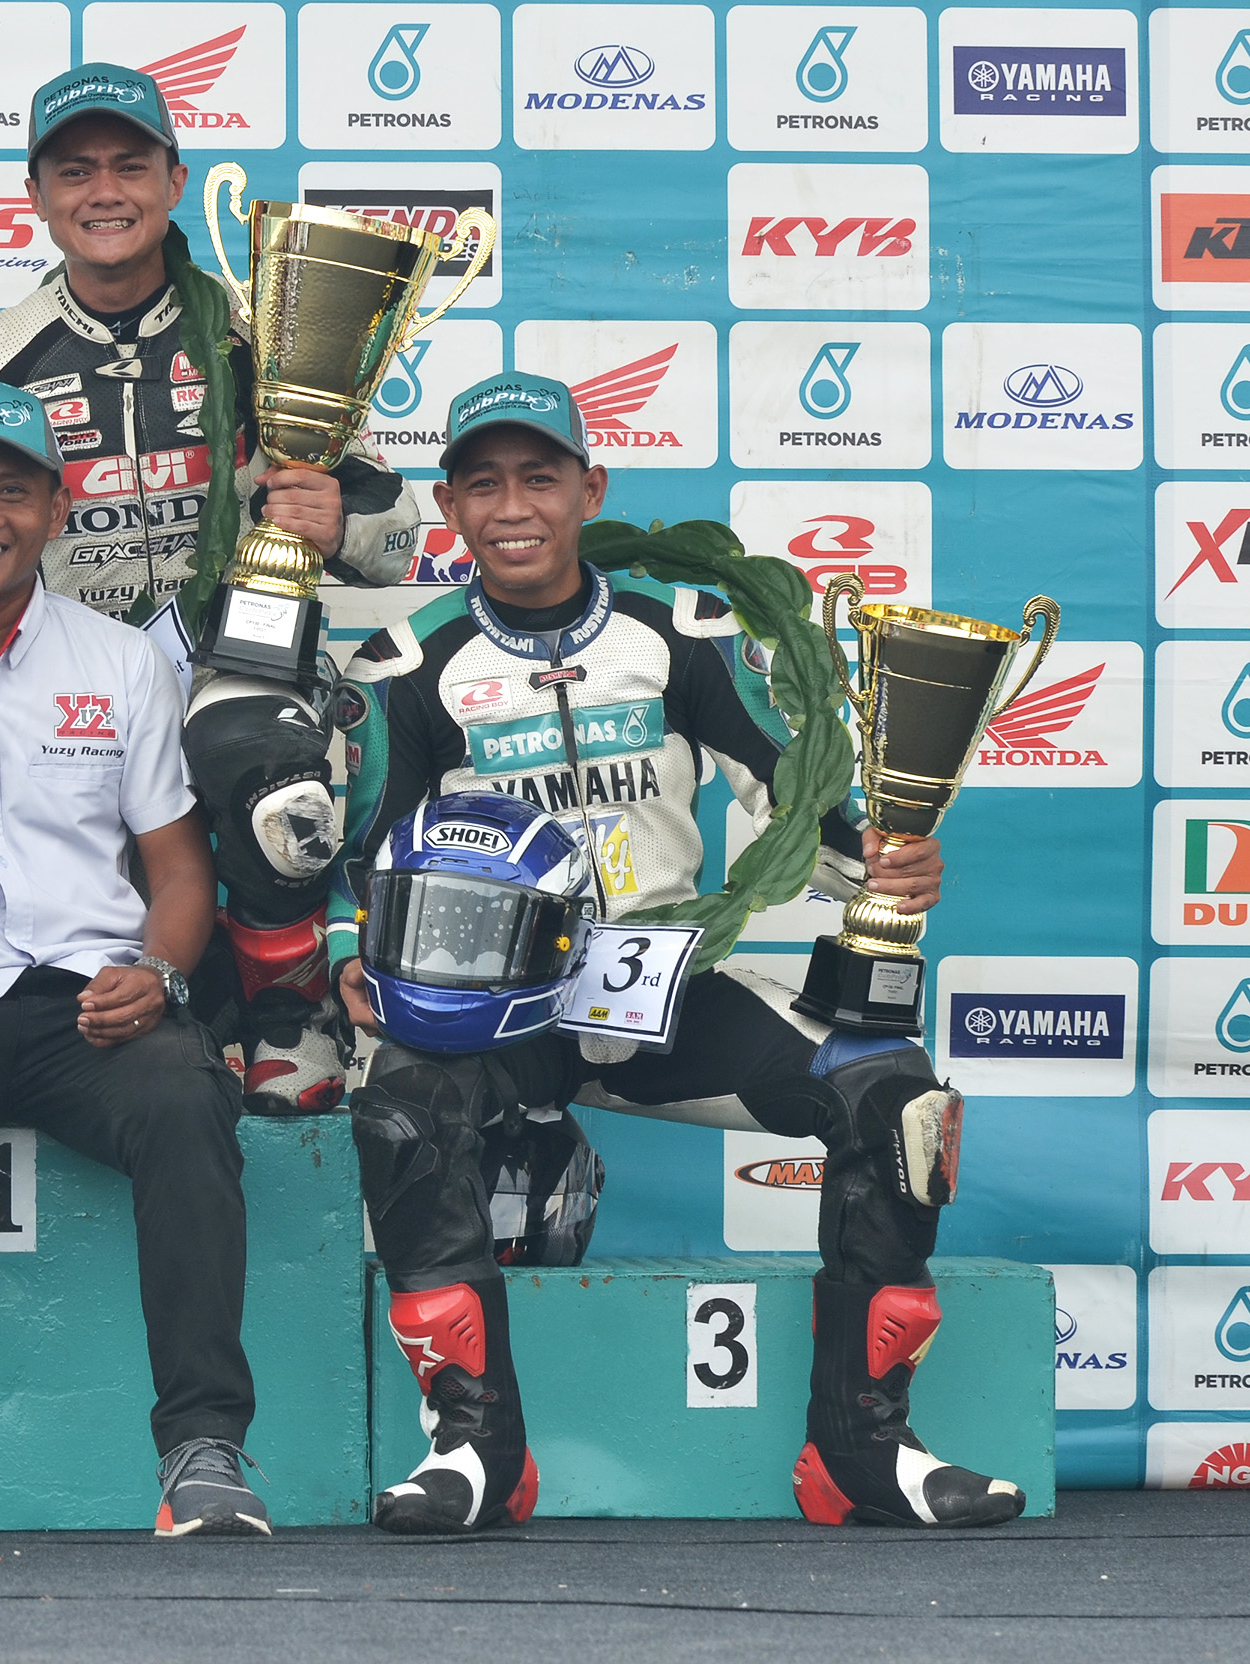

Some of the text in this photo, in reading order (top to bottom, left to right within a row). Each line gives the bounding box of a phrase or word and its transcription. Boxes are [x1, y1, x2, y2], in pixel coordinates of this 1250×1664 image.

[1001, 64, 1111, 91] YAMAHA
[43, 75, 110, 106] PETRONAS
[45, 84, 126, 114] CubPrix
[981, 93, 1103, 102] RACING
[524, 93, 705, 110] MODENAS
[173, 112, 251, 129] NDA
[348, 114, 451, 127] PETRONAS
[777, 115, 878, 129] PETRONAS
[1197, 117, 1250, 132] PETRO
[742, 217, 916, 256] KYB
[1183, 217, 1250, 259] KT
[54, 286, 94, 334] TAICHI
[176, 386, 206, 403] RK-
[457, 384, 523, 414] PETRONAS
[458, 392, 538, 423] CubPrix
[954, 413, 1133, 429] MODENAS
[373, 431, 447, 445] TRONA
[587, 431, 682, 448] ONDA
[780, 432, 881, 446] PETRONAS
[1201, 433, 1250, 448] PETRO
[82, 450, 188, 494] GIVI
[806, 565, 907, 594] CB
[78, 586, 135, 603] Yuzy
[570, 574, 608, 645] KUSHITANI
[470, 595, 534, 653] KUSHITANI
[459, 699, 509, 714] RACING BOY
[483, 720, 617, 760] PETRONAS
[41, 745, 125, 759] Yuzy Racing
[979, 750, 1108, 766] HONDA
[1202, 751, 1250, 766] PETRO
[492, 757, 661, 812] YAMAHA
[436, 827, 501, 850] SHOEI
[1183, 903, 1250, 926] DU
[602, 937, 662, 993] 3 rd
[590, 1009, 610, 1019] AAM
[999, 1010, 1109, 1036] YAMAHA
[977, 1038, 1100, 1046] RACING
[1194, 1063, 1250, 1077] PETRO
[1161, 1162, 1250, 1202] KY
[692, 1297, 750, 1390] 3
[1194, 1374, 1250, 1389] PETRO
[1206, 1465, 1250, 1485] NG
